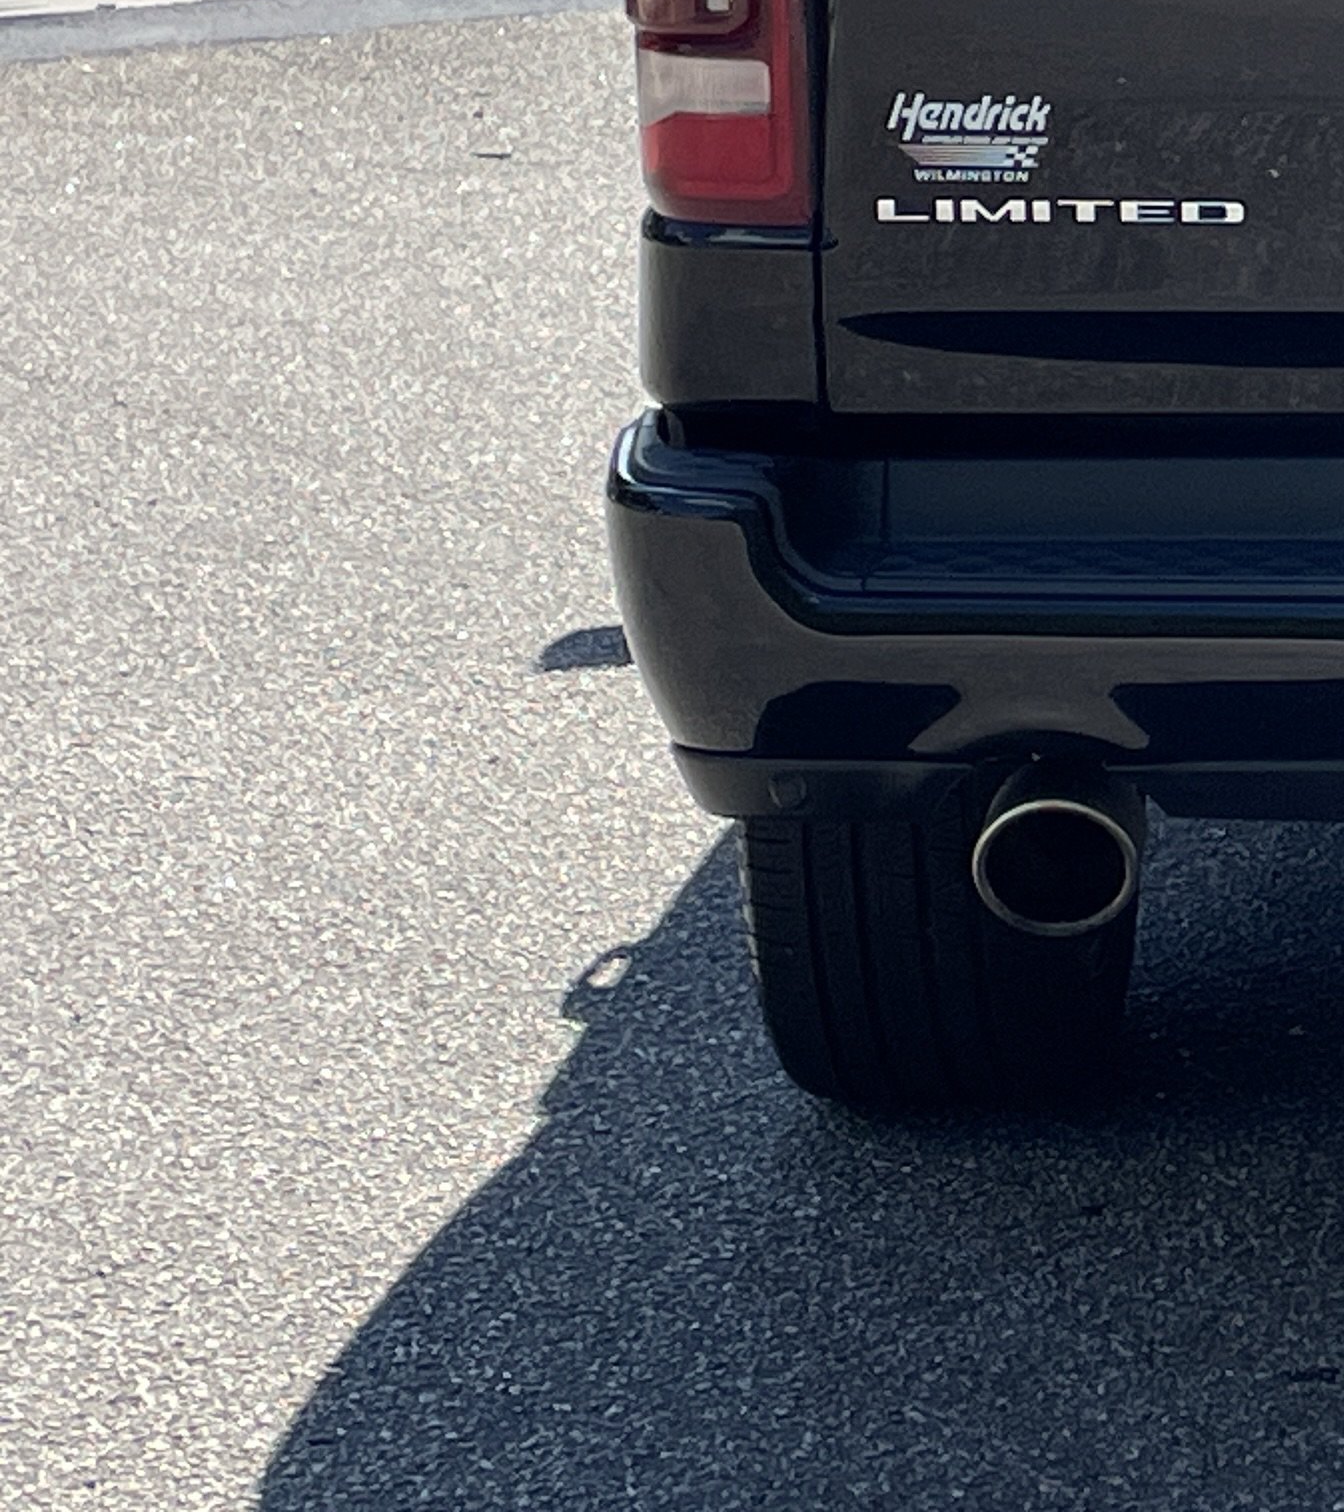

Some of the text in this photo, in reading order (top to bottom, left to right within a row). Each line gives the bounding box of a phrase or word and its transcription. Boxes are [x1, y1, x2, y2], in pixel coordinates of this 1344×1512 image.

[887, 92, 1051, 142] Hendrick
[913, 169, 1030, 183] WILMINGTON
[875, 198, 1246, 224] LIMITED
